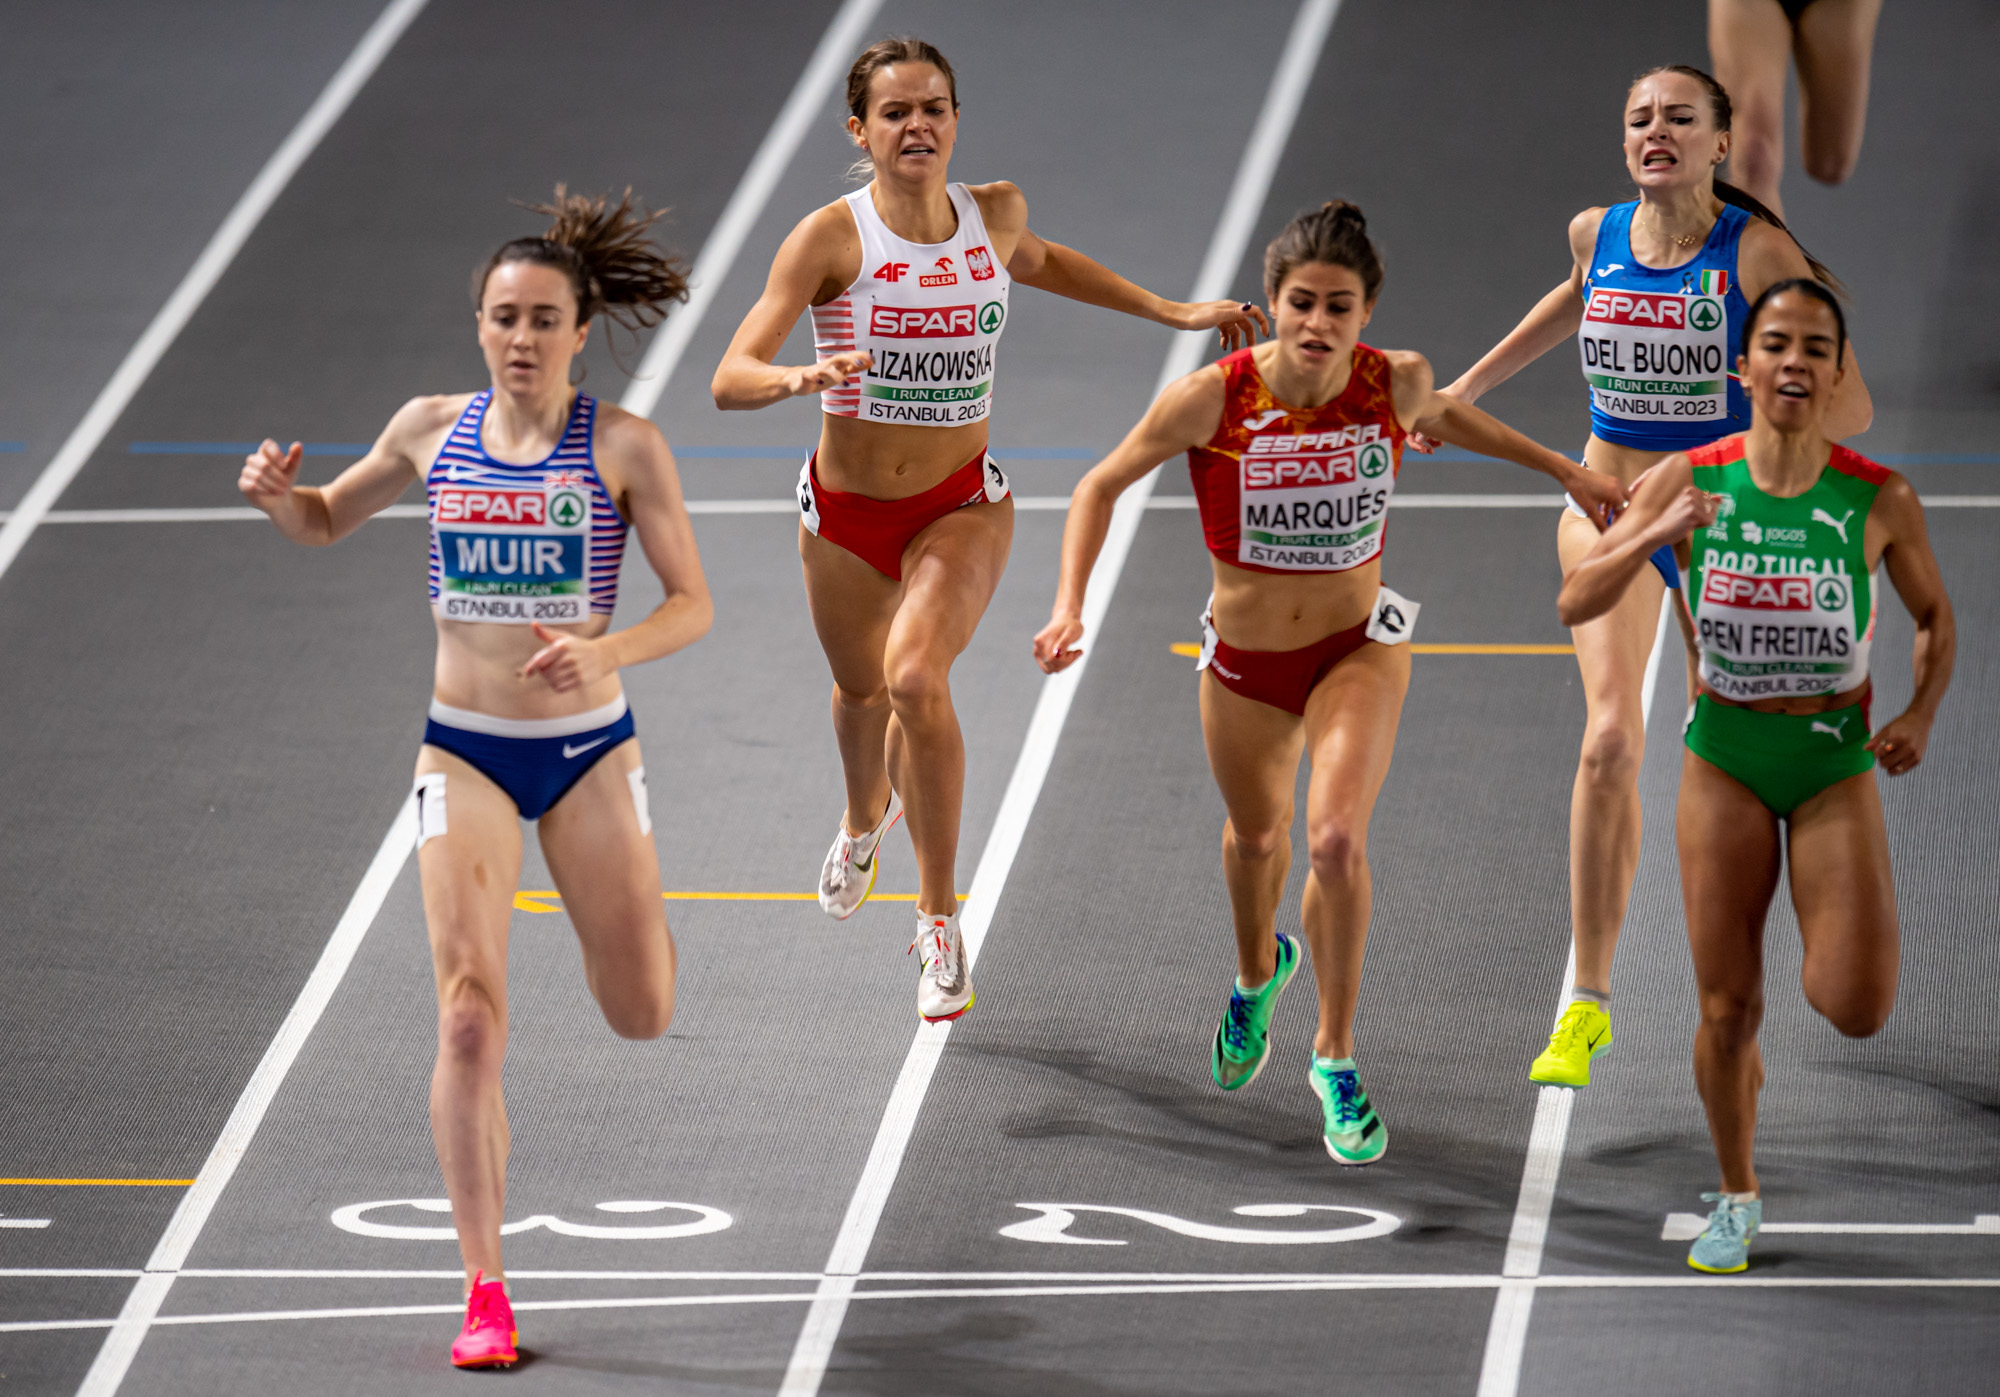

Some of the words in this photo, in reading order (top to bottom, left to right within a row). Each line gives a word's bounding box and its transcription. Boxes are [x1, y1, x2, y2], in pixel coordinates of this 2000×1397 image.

[921, 275, 955, 287] ORLEN
[873, 309, 973, 334] SPAR
[1589, 295, 1683, 325] SPAR
[867, 344, 992, 382] LIZAKOWSKA
[1584, 337, 1626, 372] DEL
[1634, 342, 1722, 375] BUONO
[900, 389, 929, 400] RUN
[1614, 378, 1641, 391] RUN
[870, 402, 954, 421] ISTANBUL
[958, 400, 986, 420] 2023
[1674, 399, 1717, 415] 2023
[1248, 424, 1381, 453] ESPAÑA
[1247, 457, 1354, 486] SPAR
[441, 492, 544, 524] SPAR
[1247, 488, 1387, 531] MARQUÉS
[1280, 535, 1310, 545] RUN
[1314, 532, 1359, 546] CLEAN
[1765, 527, 1807, 542] JOGOS
[456, 537, 565, 575] MUIR
[1250, 545, 1338, 565] ISTANBUL
[1707, 574, 1810, 607] SPAR
[447, 598, 529, 618] ISTANBUL
[534, 601, 579, 618] 2023
[1701, 618, 1743, 656] PEN
[1751, 625, 1849, 657] FREITAS
[331, 1199, 733, 1240] 3
[999, 1203, 1401, 1245] 2
